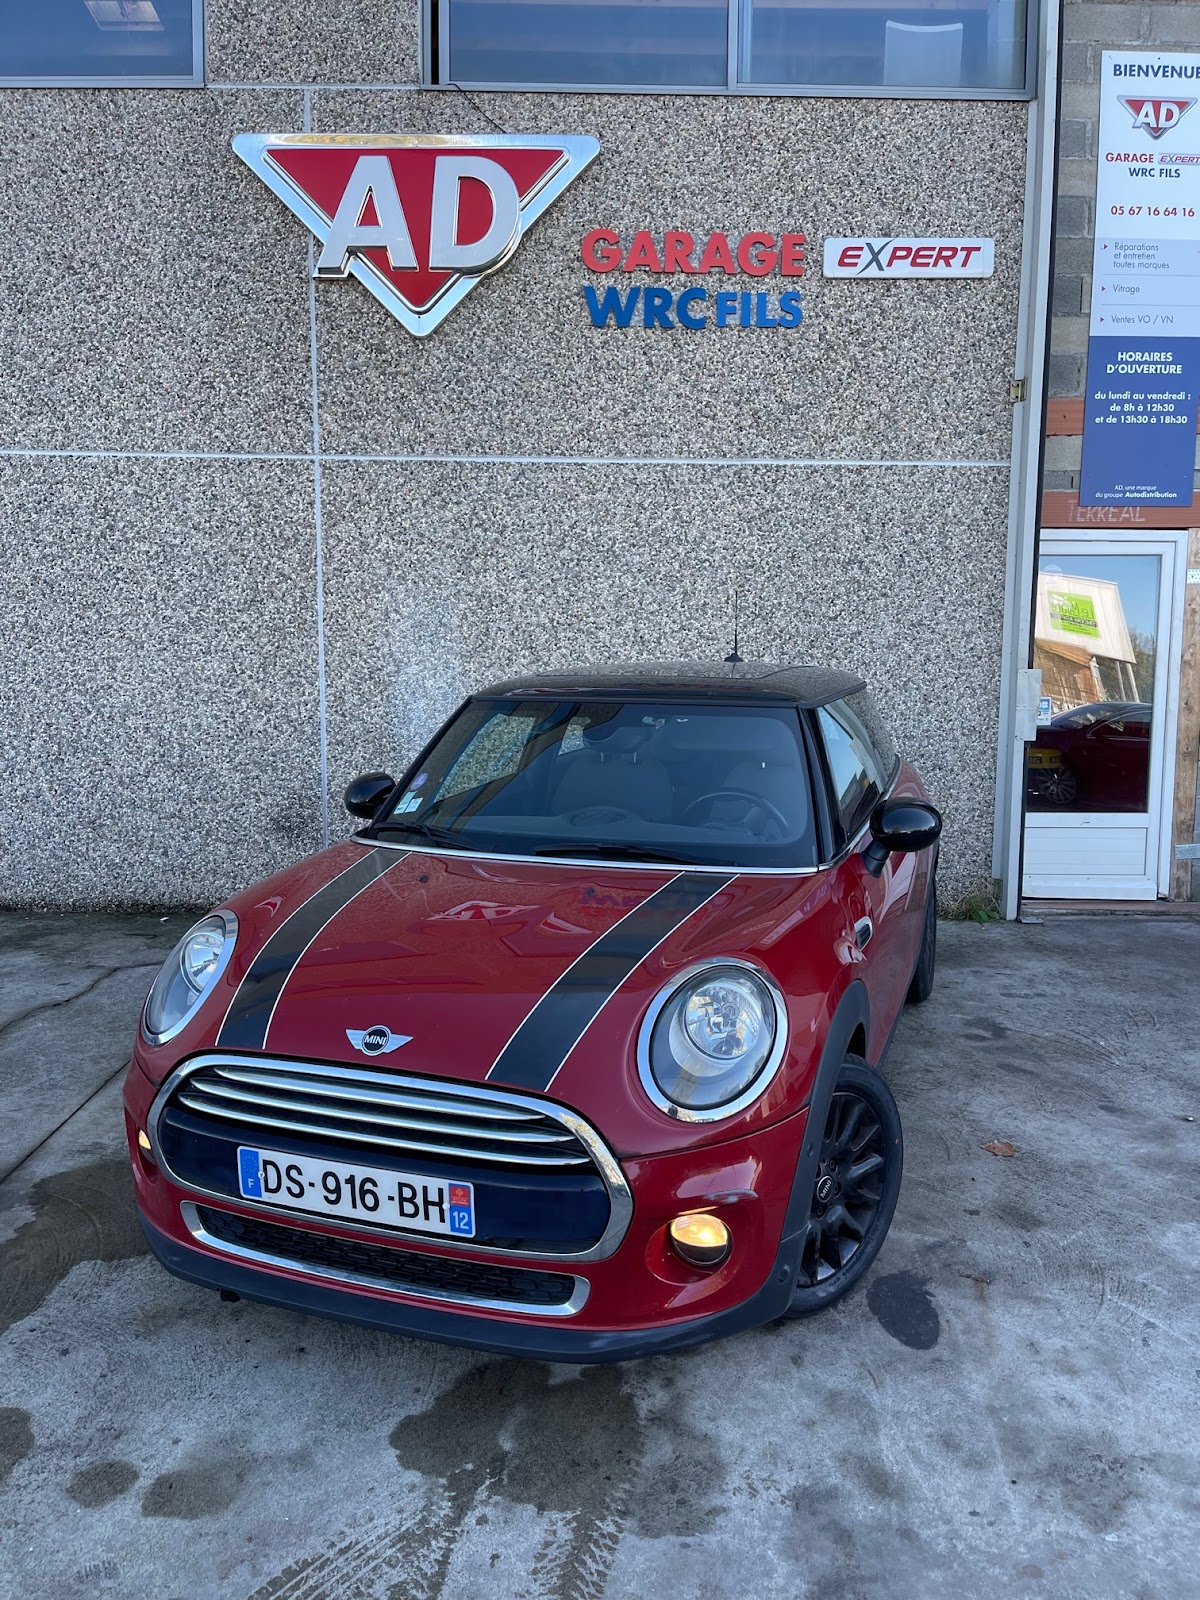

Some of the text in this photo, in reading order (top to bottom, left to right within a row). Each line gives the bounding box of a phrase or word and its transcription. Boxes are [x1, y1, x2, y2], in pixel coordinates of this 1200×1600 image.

[1113, 64, 1200, 79] BIENVENUE
[1132, 101, 1180, 128] AD
[1105, 152, 1200, 164] GARAGE EXPERT
[1129, 167, 1181, 178] WRC FILS
[314, 153, 521, 278] AD
[1111, 206, 1195, 217] 05 67 16 64 16
[581, 229, 982, 277] GARAGE EXPERT
[1114, 242, 1159, 253] Réparations
[1113, 252, 1156, 260] et entretien
[1113, 261, 1170, 271] toutes marques
[1113, 284, 1140, 295] Vitrage
[584, 285, 803, 329] WRC FILS
[1111, 315, 1135, 323] Ventes
[1137, 315, 1151, 323] VO
[1160, 315, 1174, 324] VN
[1117, 352, 1173, 362] HORAIRES
[1094, 391, 1106, 400] du
[1108, 391, 1131, 400] lundi
[1147, 391, 1185, 401] vendredi
[1110, 403, 1174, 412] de 8h à 12h30
[1095, 415, 1188, 424] et de 13h30 à 18h30
[1104, 492, 1123, 500] groupe
[364, 1035, 386, 1045] MINI
[248, 1178, 255, 1189] F
[820, 1179, 832, 1198] MINI
[262, 1159, 446, 1223] DS-916-BH
[452, 1210, 469, 1230] 12
